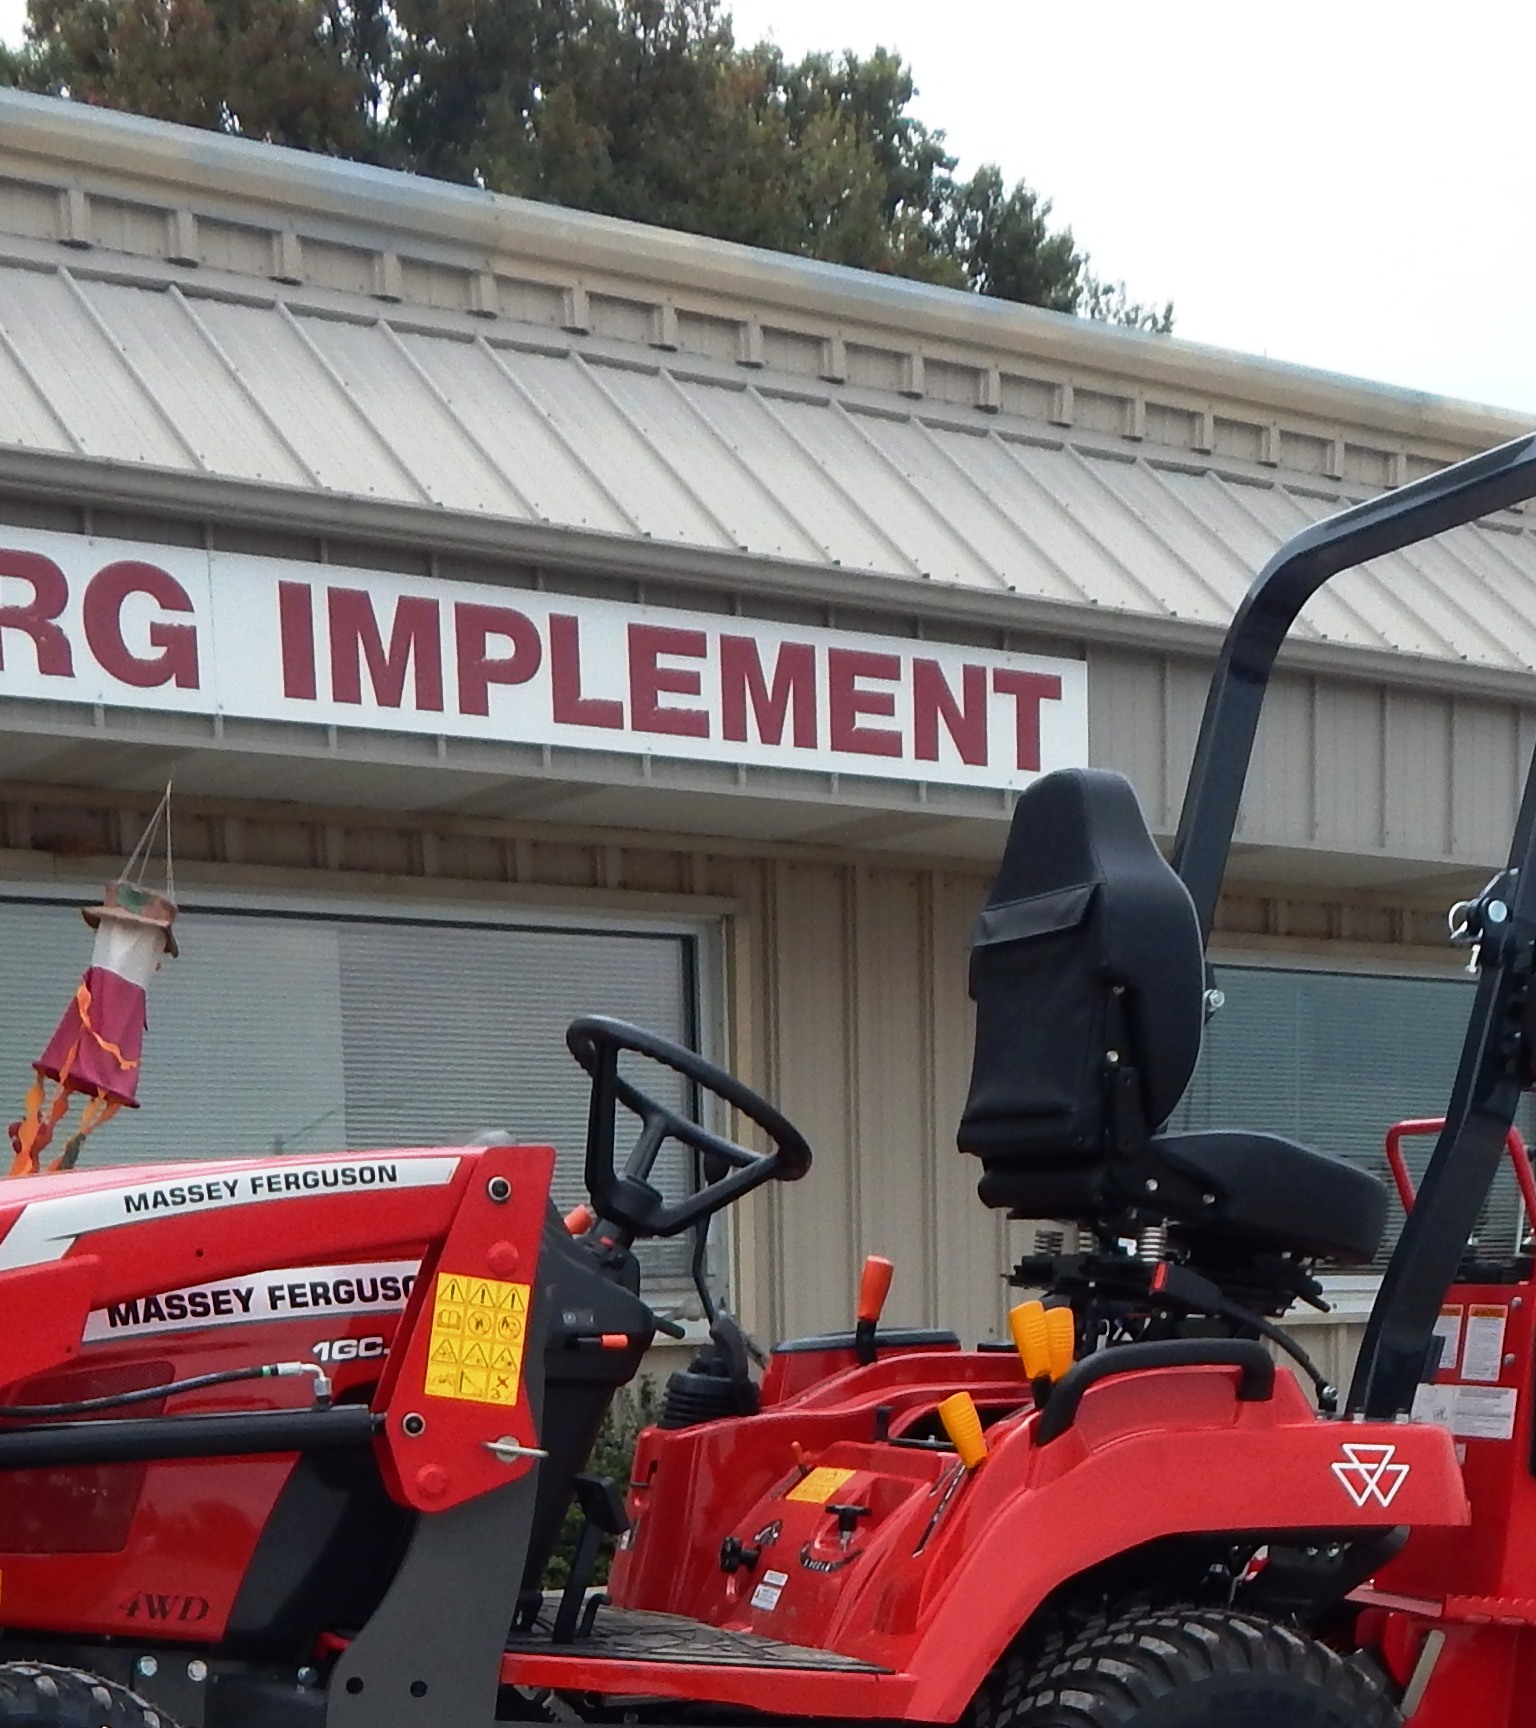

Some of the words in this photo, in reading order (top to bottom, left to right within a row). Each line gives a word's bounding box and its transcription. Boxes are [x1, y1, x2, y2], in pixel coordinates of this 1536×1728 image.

[279, 579, 1062, 772] IMPLEMENT
[123, 1179, 239, 1213] MASSEY
[250, 1164, 398, 1195] FERGUSON
[107, 1287, 254, 1328] MASSEY
[267, 1274, 417, 1311] FERGUS
[118, 1590, 209, 1621] 4WD
